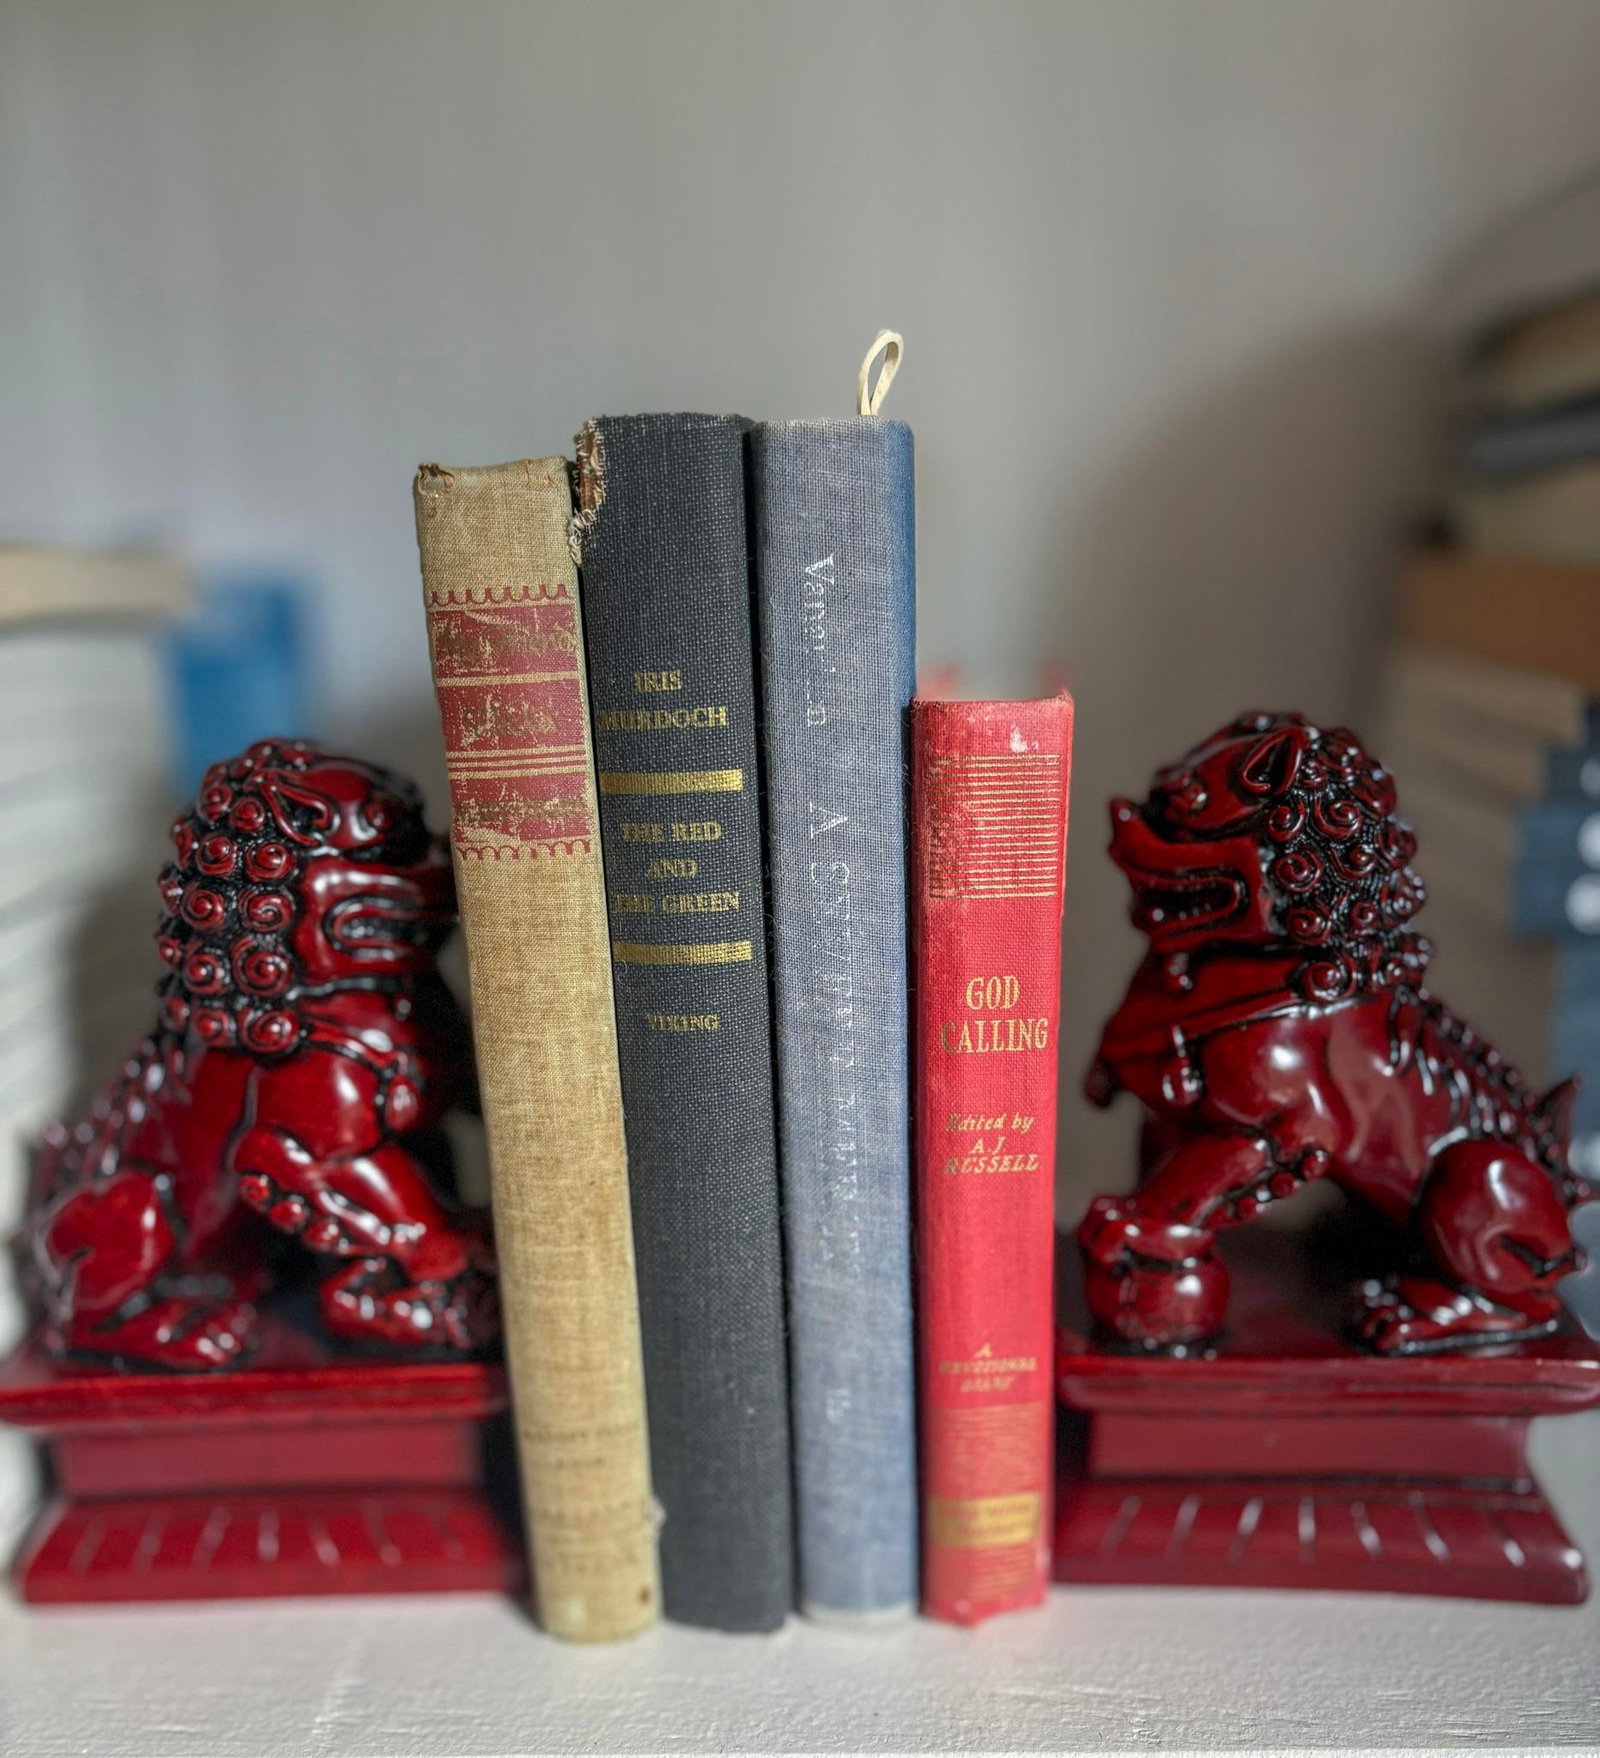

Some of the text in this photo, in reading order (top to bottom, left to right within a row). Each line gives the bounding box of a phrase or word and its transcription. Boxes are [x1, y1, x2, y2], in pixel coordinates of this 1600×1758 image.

[804, 553, 835, 727] Vanan
[632, 670, 683, 692] IRIS
[599, 706, 728, 731] MURDOCH
[810, 801, 849, 838] A
[619, 820, 723, 843] THE RED
[648, 859, 698, 879] AND
[612, 892, 741, 913] THE GREEN
[965, 975, 1020, 1011] GOD
[646, 1013, 719, 1032] VIKING
[940, 1017, 1049, 1054] CALLING
[946, 1112, 1034, 1134] Edited by
[943, 1153, 1040, 1176] RUSSELL
